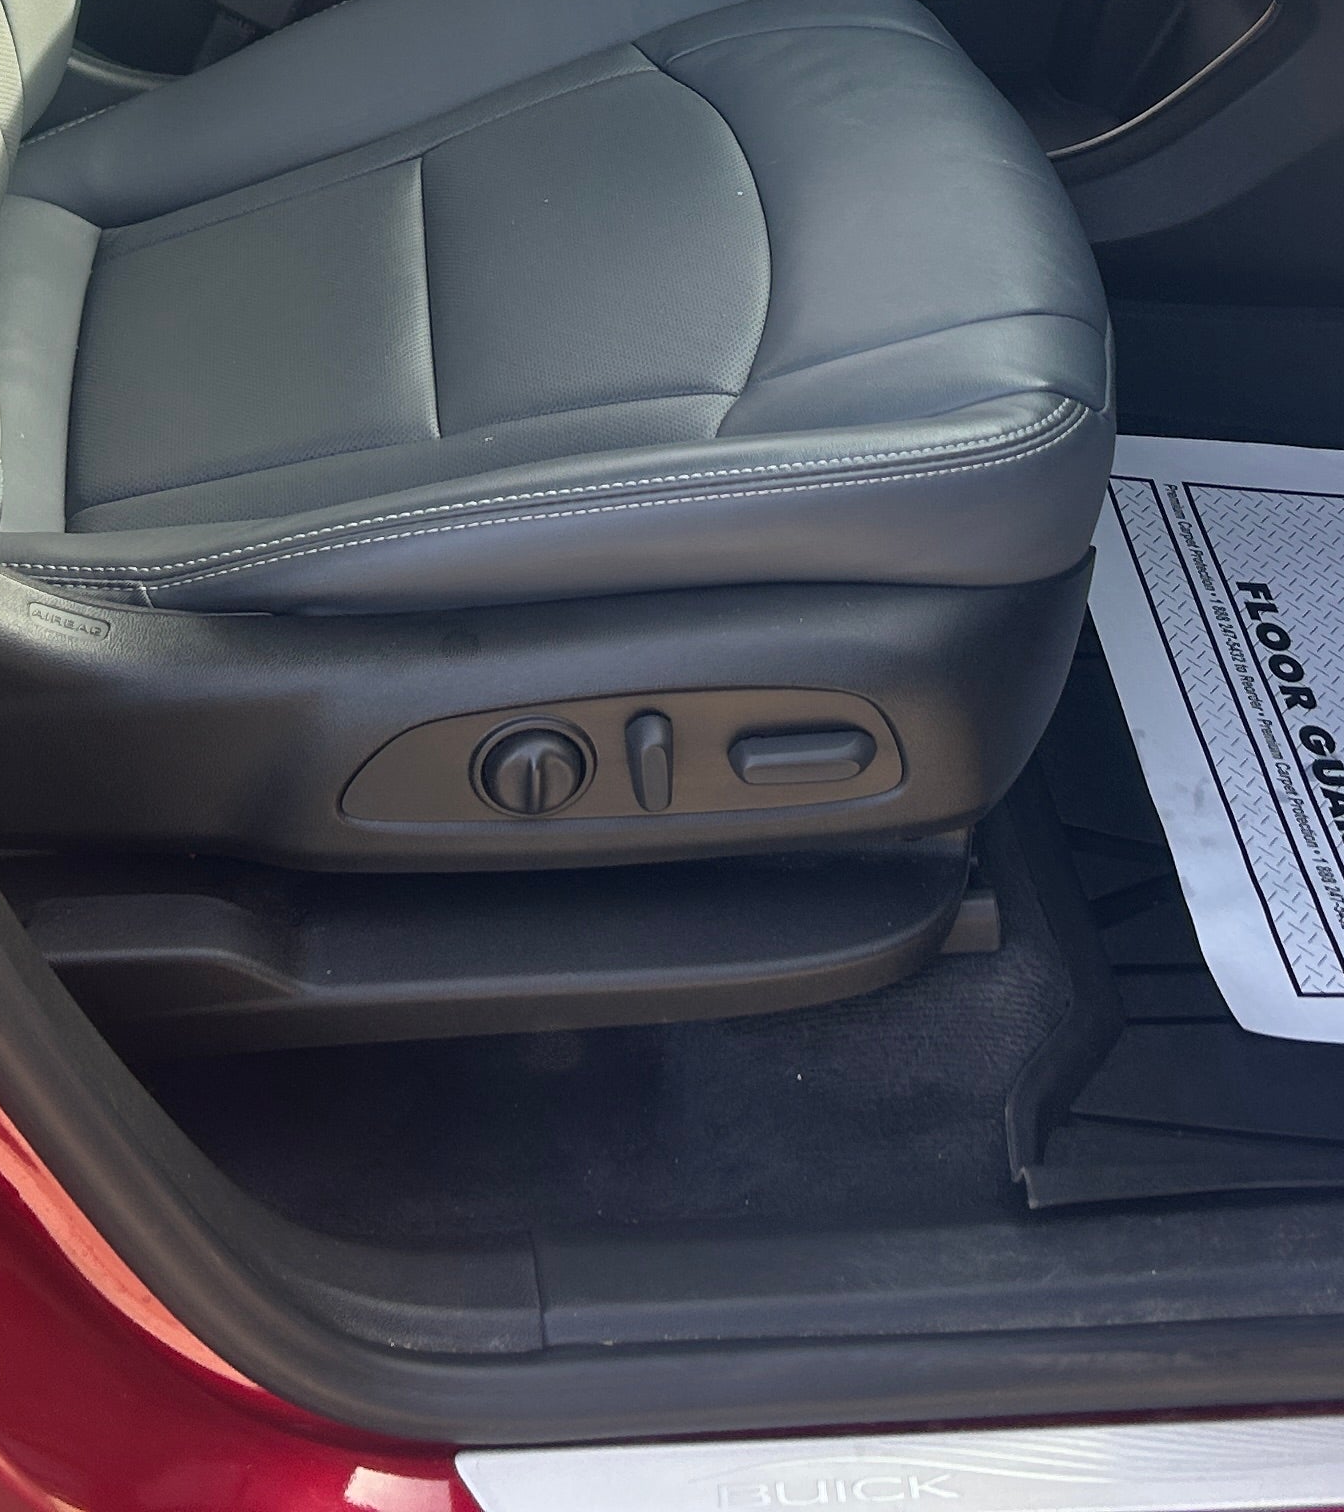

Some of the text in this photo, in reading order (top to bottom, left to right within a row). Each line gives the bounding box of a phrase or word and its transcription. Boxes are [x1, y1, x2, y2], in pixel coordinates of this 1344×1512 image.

[1163, 483, 1186, 519] Premium
[1177, 520, 1201, 550] Carpet
[1188, 548, 1217, 592] Protection
[32, 609, 102, 636] AIRBAG
[1235, 581, 1318, 710] FLOOR
[1238, 674, 1265, 712] Reorder
[1257, 718, 1285, 760] Premium
[1274, 762, 1299, 796] Carpet
[1287, 796, 1320, 849] Protection
[716, 1473, 961, 1509] BUICK
